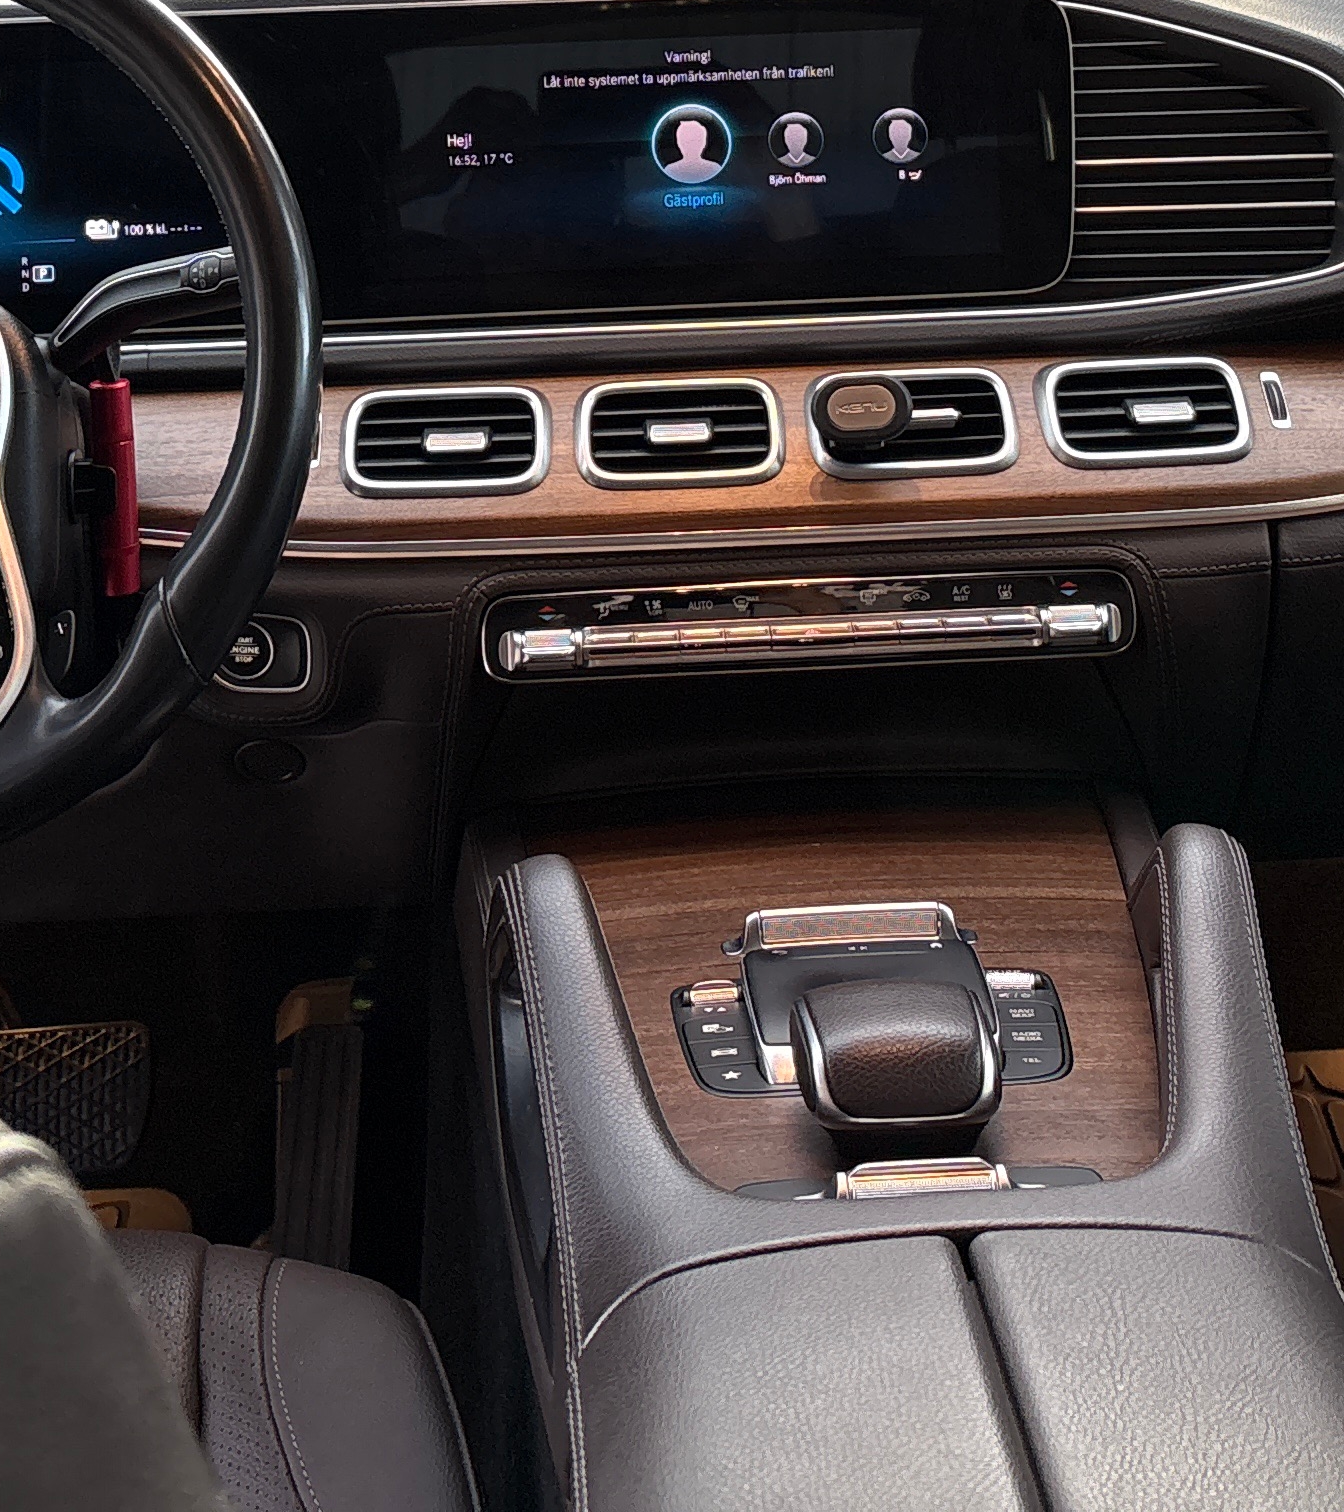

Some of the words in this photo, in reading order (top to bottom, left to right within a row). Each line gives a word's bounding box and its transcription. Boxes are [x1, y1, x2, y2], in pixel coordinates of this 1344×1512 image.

[664, 50, 712, 65] Varning!
[543, 74, 561, 88] Låt
[564, 74, 586, 88] inte
[588, 73, 640, 89] systemet
[642, 73, 654, 85] ta
[656, 69, 760, 87] uppmärksamheten
[763, 66, 786, 80] från
[788, 64, 835, 79] trafiken!
[447, 133, 472, 149] Hej!
[448, 154, 481, 167] 16:52,
[484, 153, 497, 165] 17
[499, 152, 514, 164] °C
[769, 174, 793, 187] Björn
[664, 192, 725, 209] Gästprofil
[123, 224, 144, 236] 100
[146, 224, 154, 235] %
[21, 257, 29, 266] R
[21, 269, 30, 279] N
[40, 267, 48, 280] P
[22, 282, 30, 293] D
[834, 400, 889, 416] KENU
[952, 585, 971, 594] A/C
[687, 600, 714, 611] AUTO
[230, 646, 260, 654] NGINE
